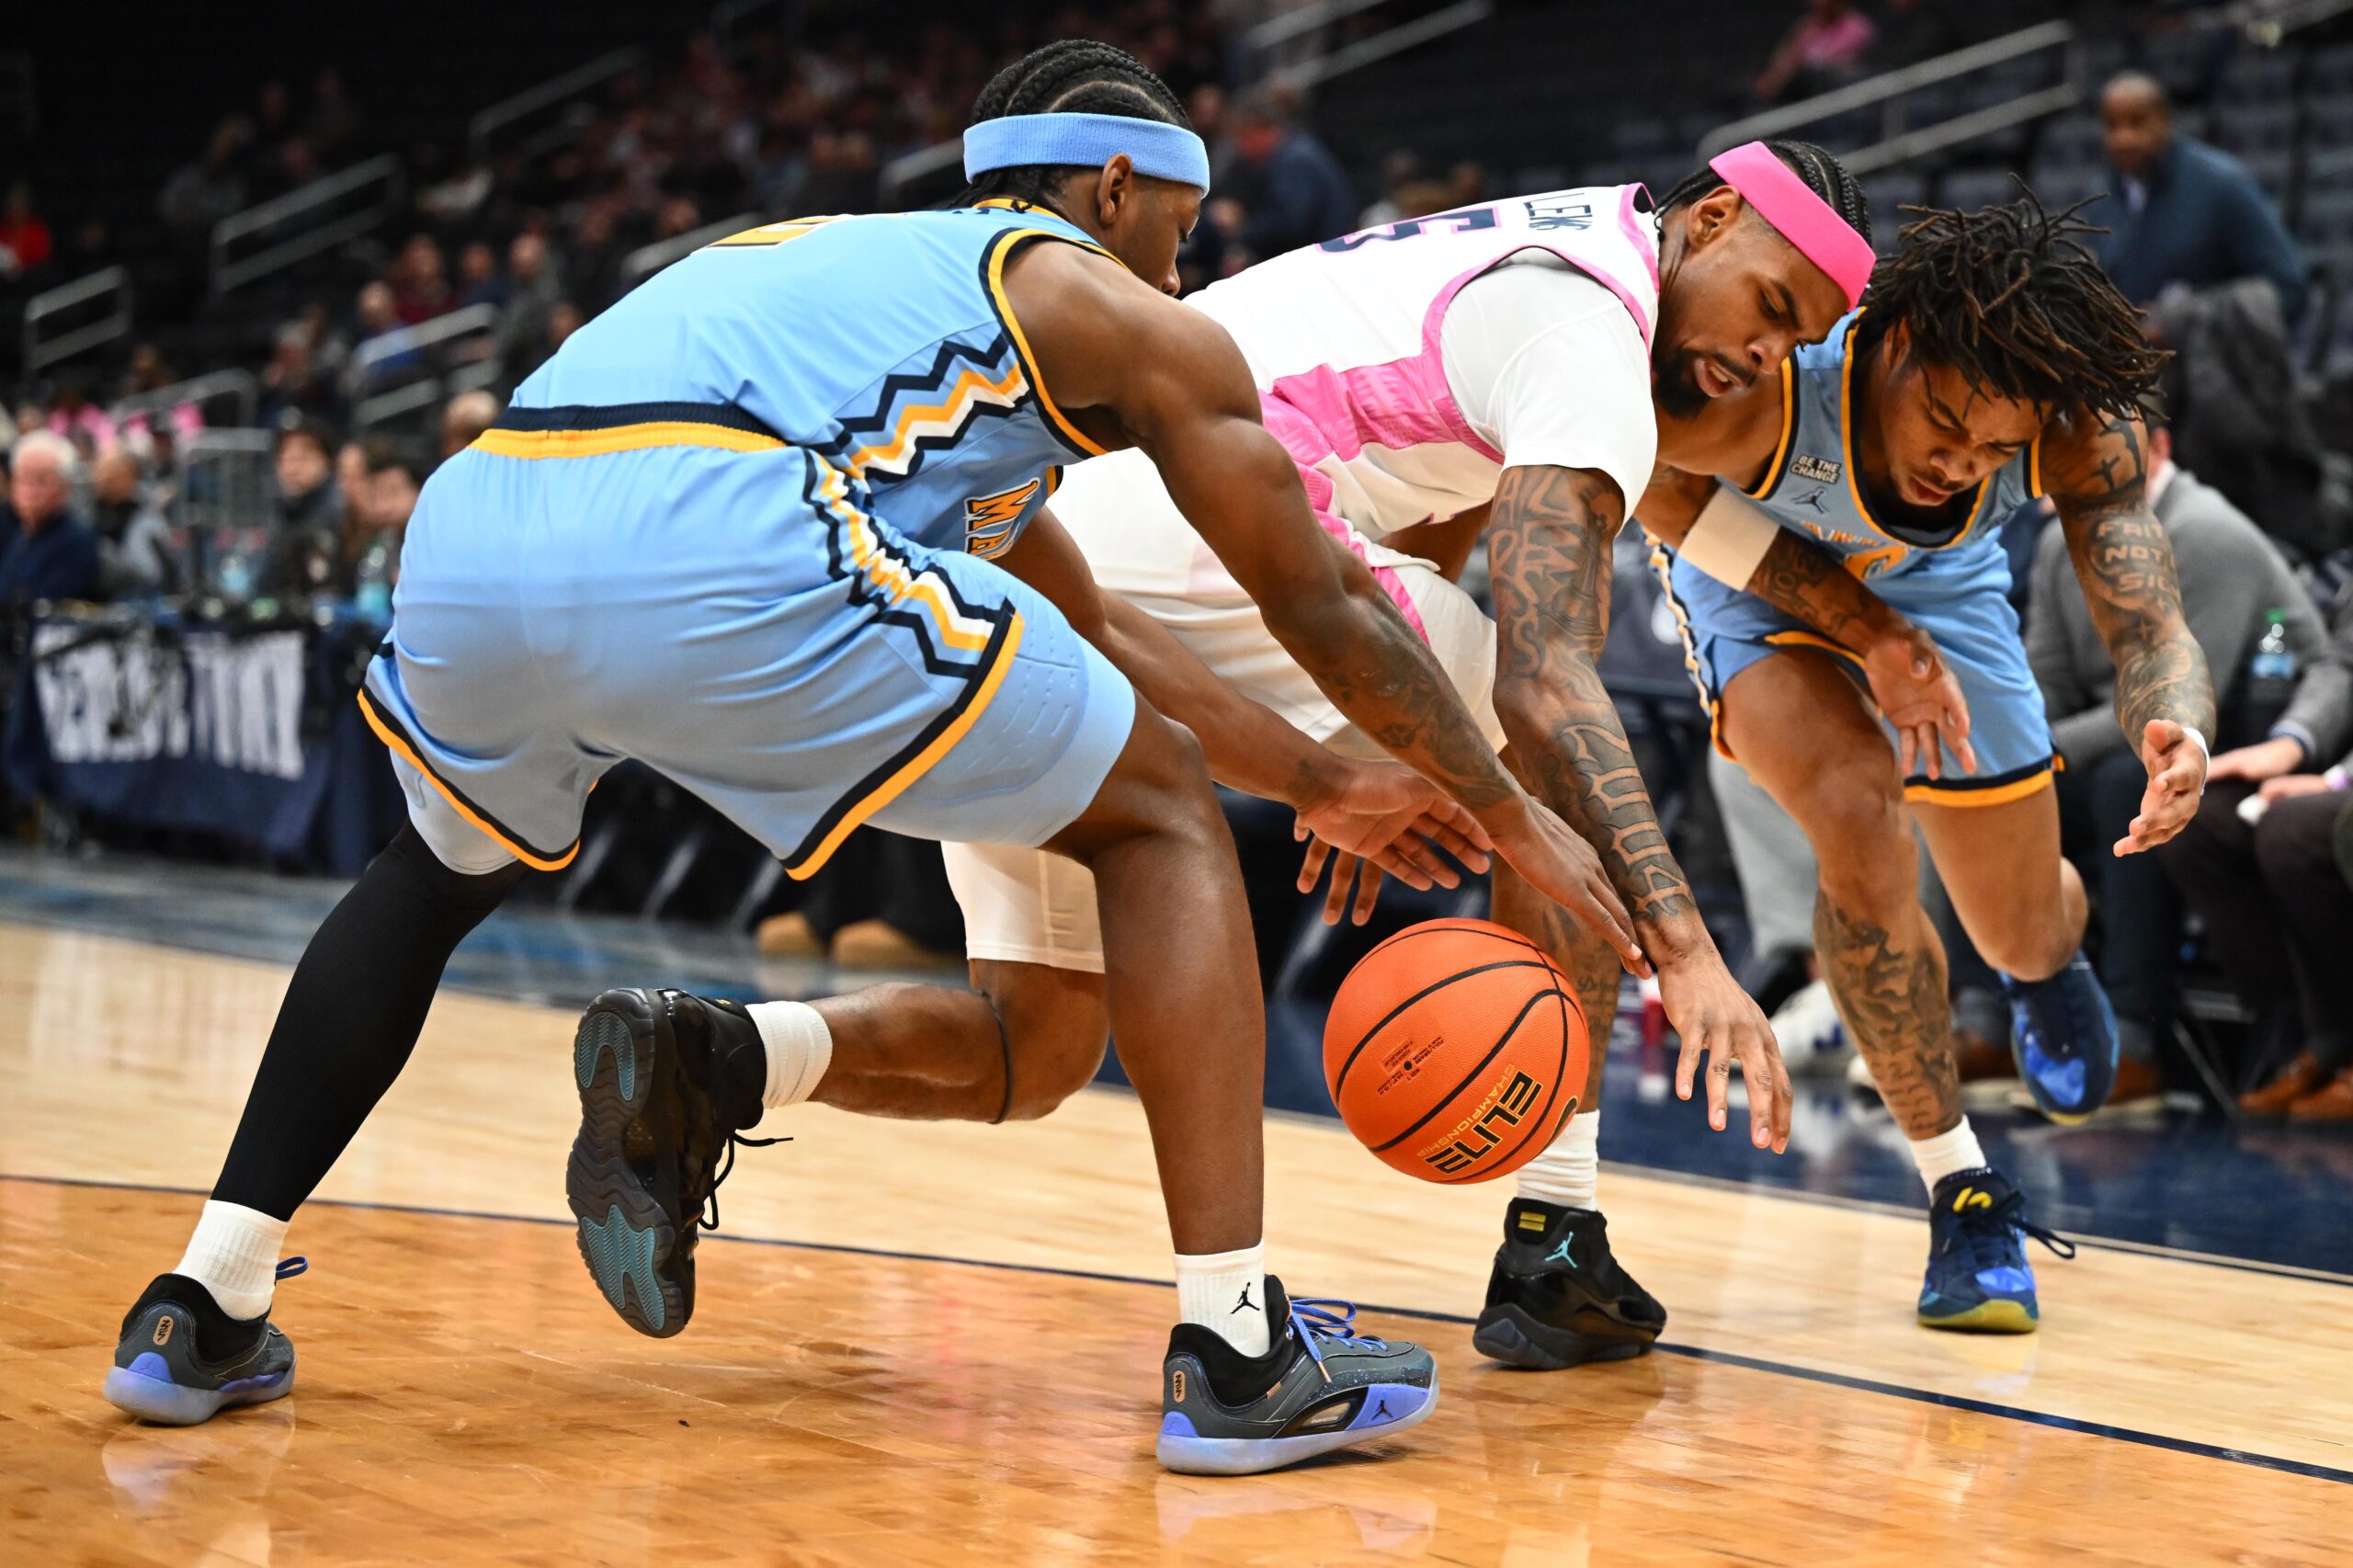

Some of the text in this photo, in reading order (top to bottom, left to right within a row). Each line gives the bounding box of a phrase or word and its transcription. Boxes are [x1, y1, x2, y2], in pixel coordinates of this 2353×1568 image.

[1790, 464, 1837, 483] CHANGE
[1799, 454, 1838, 473] BE THE
[1416, 1062, 1516, 1157] CHAMPIONSHIP
[1426, 1070, 1541, 1175] ELITE
